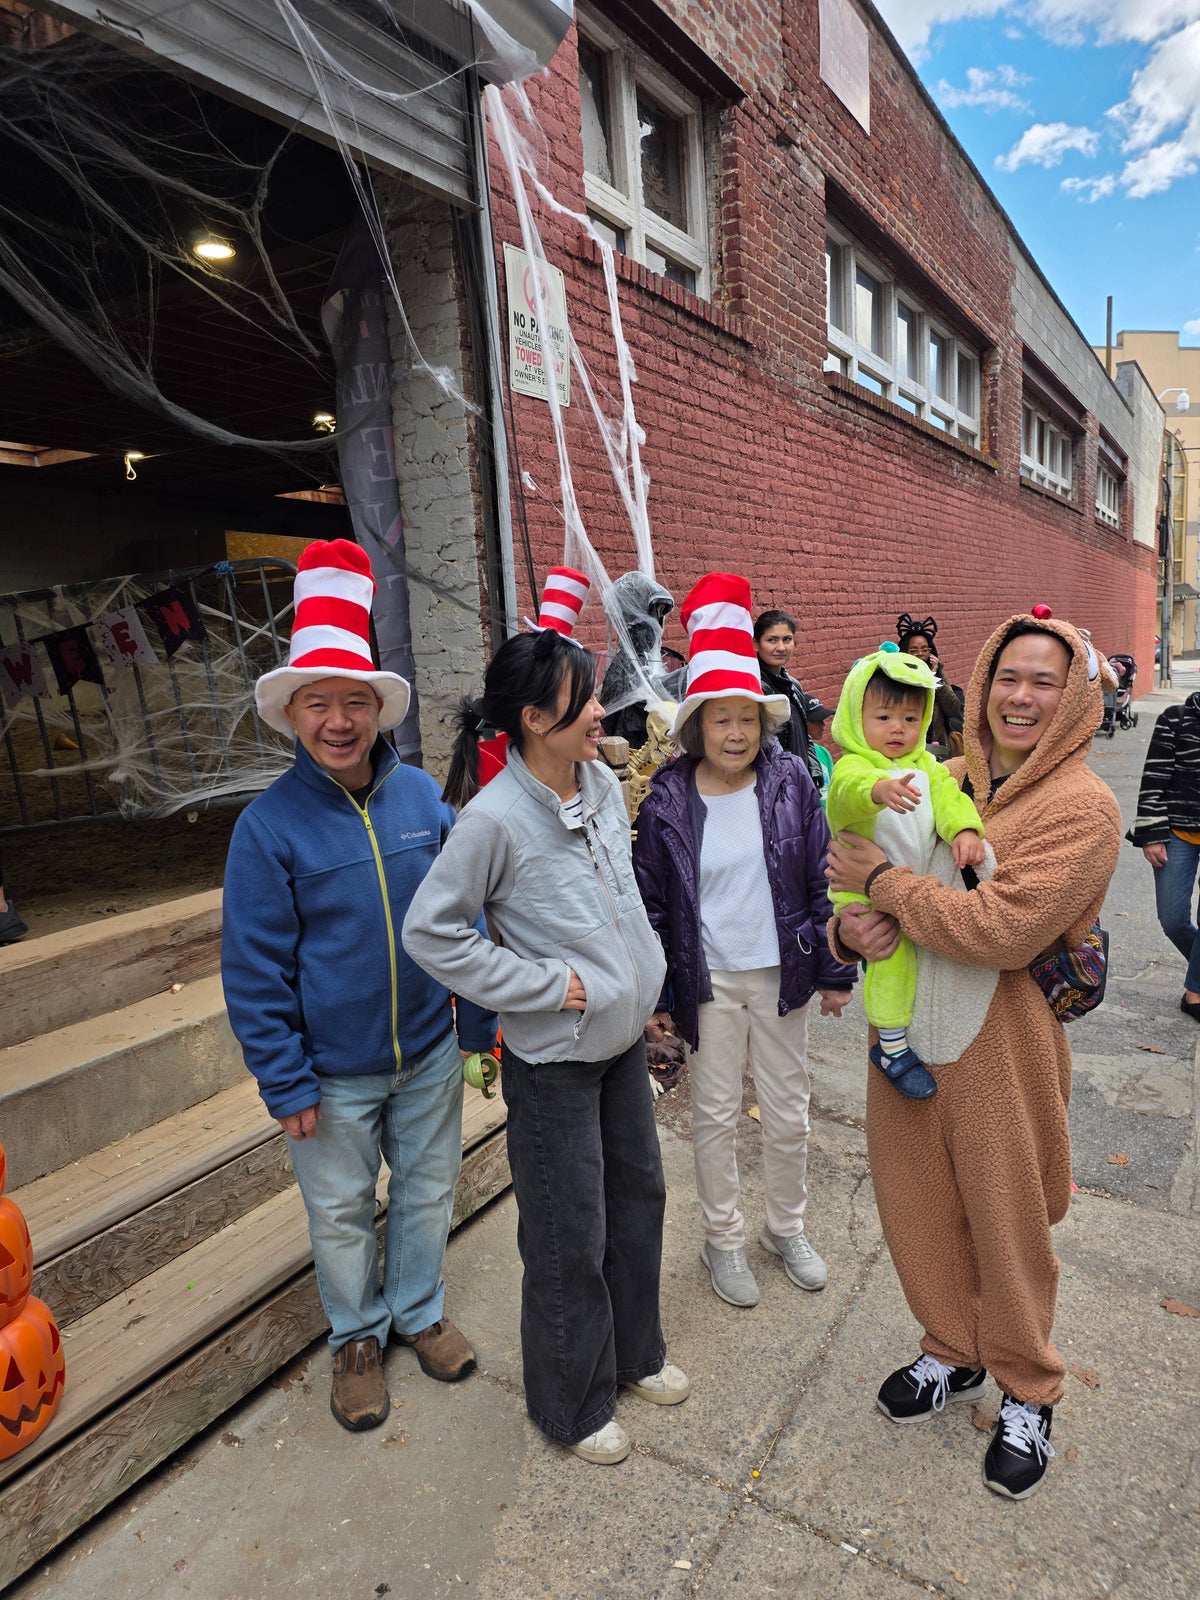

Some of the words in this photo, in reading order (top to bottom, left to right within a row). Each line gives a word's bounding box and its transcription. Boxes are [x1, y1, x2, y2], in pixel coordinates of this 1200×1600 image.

[513, 310, 525, 328] NO
[530, 316, 565, 343] PAING
[514, 336, 542, 352] VEHICLES
[515, 345, 542, 367] TOWED
[524, 363, 531, 372] AT
[514, 369, 541, 384] OWNER'S
